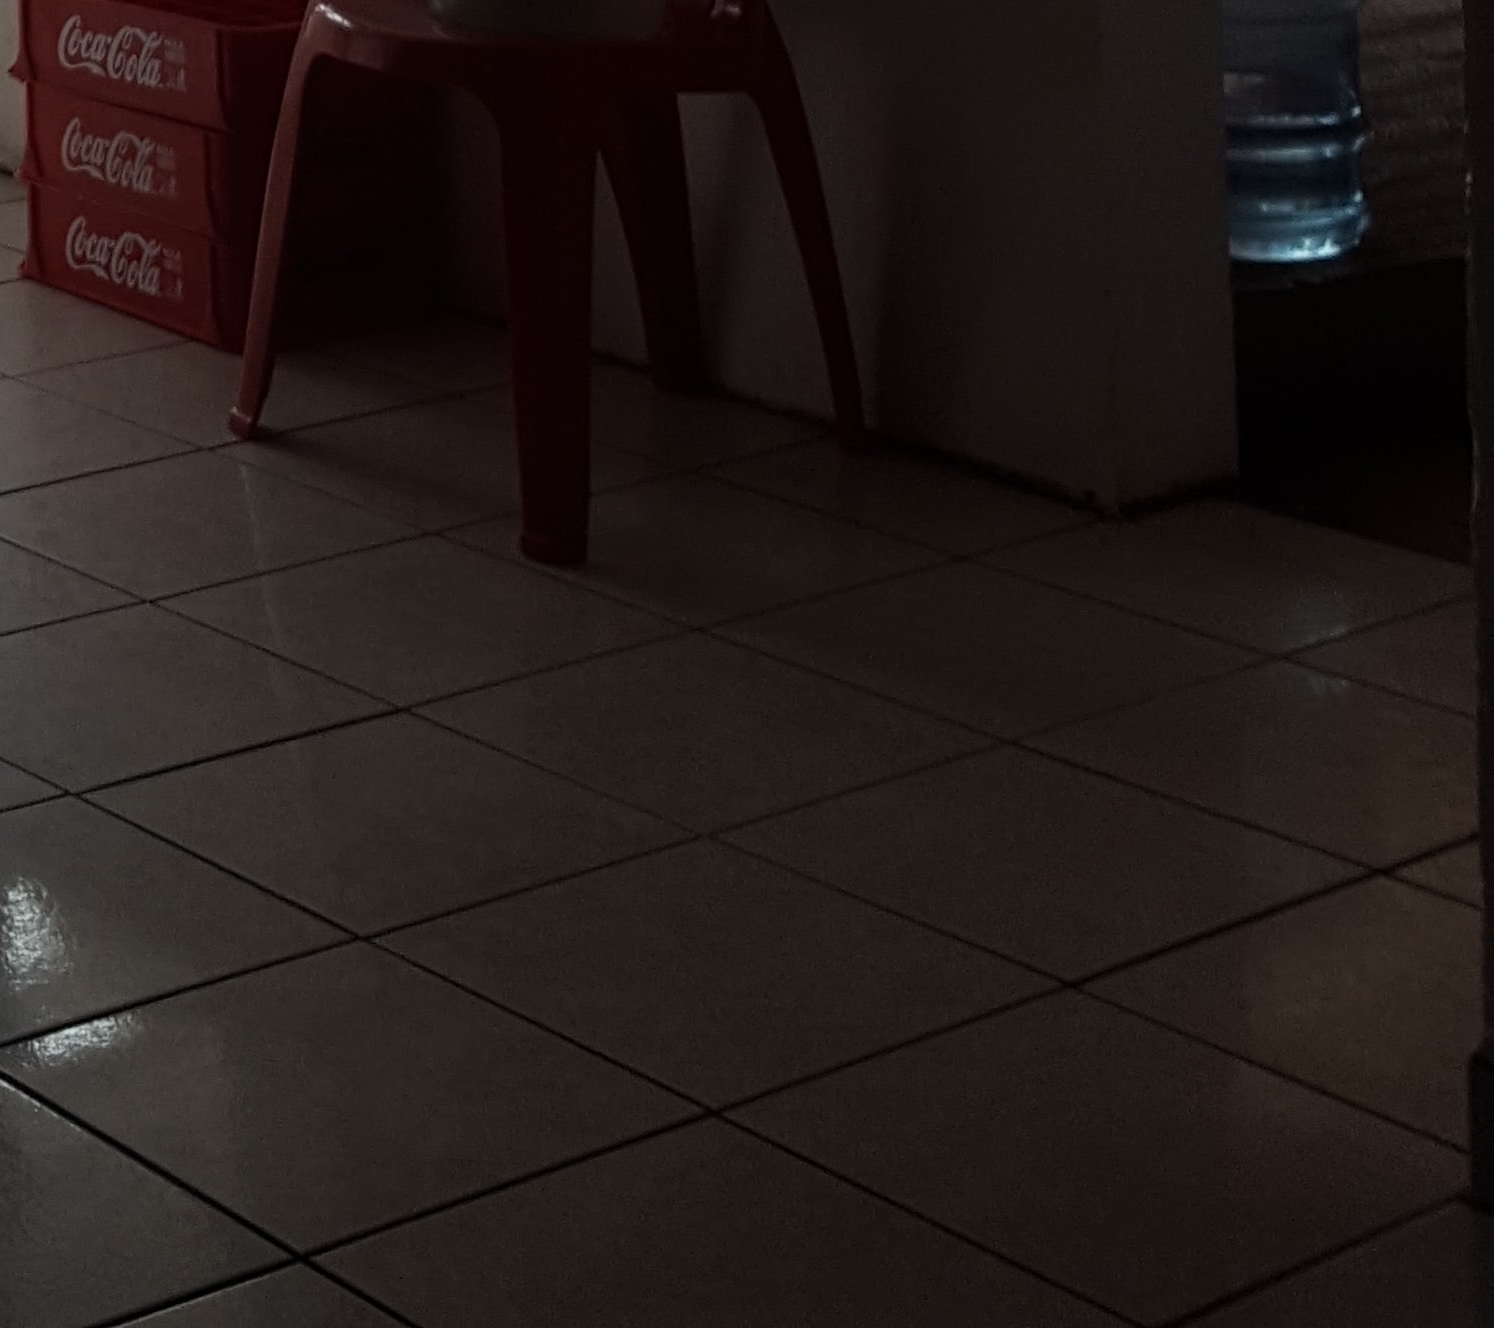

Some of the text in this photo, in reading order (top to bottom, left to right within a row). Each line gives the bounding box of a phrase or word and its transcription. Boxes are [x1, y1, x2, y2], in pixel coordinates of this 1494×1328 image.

[57, 14, 162, 88] Coca-Cola
[62, 117, 155, 193] Coca-Cola
[65, 215, 161, 295] Coca-Cola
